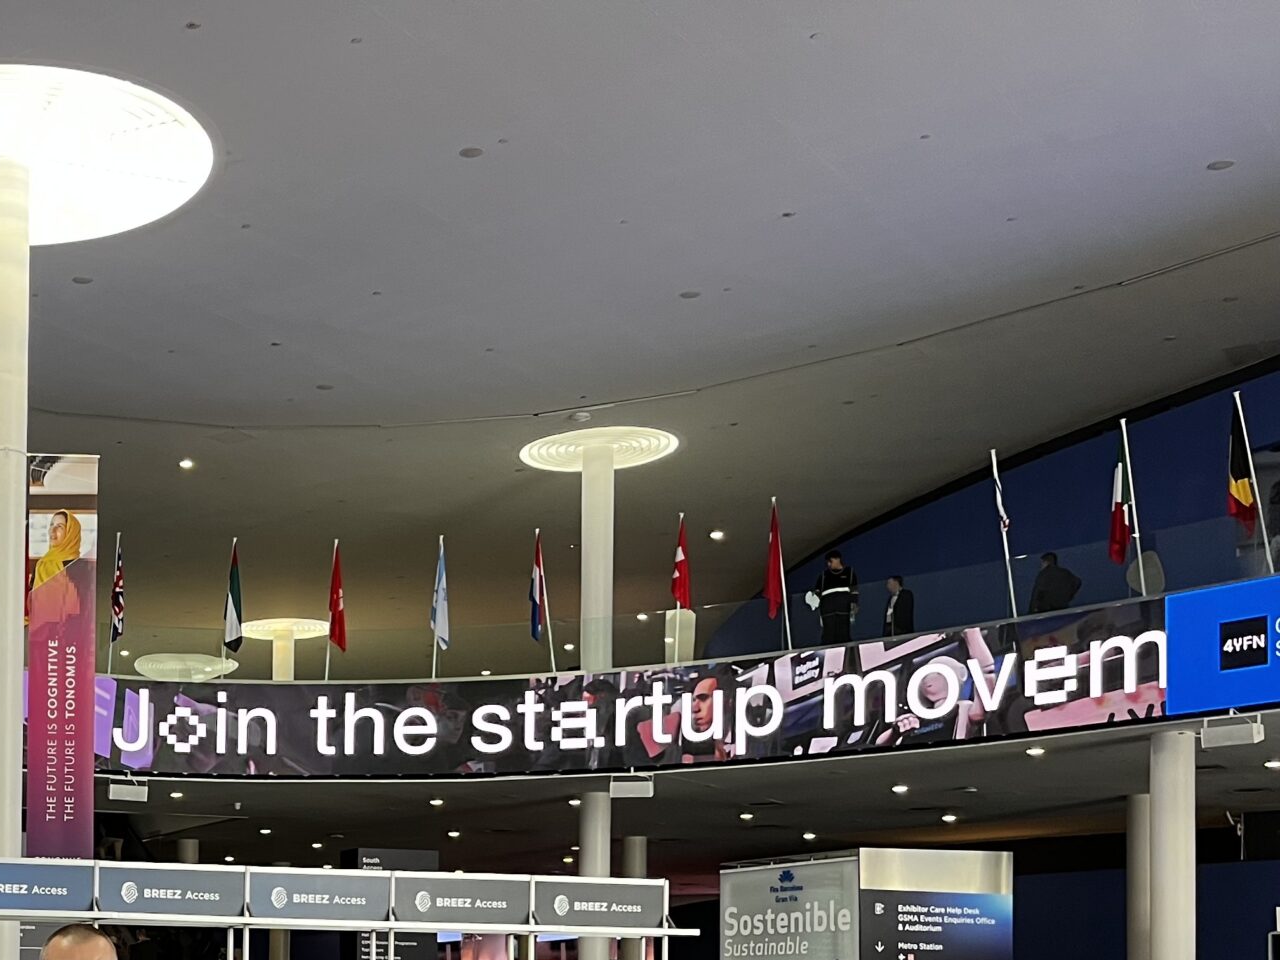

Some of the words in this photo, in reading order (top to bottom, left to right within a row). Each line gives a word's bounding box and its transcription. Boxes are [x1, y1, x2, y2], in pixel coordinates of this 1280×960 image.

[1223, 633, 1265, 653] 4YFN
[47, 636, 59, 719] COGNITIVE.
[65, 642, 77, 719] TONOMUS.
[112, 688, 277, 754] Join
[309, 692, 438, 755] the
[470, 681, 784, 757] startup
[822, 627, 1166, 730] movem
[47, 723, 58, 735] IS
[65, 723, 76, 735] IS
[46, 739, 58, 792] FUTURE
[64, 740, 76, 792] FUTURE
[46, 796, 57, 821] THE
[64, 796, 75, 821] THE
[31, 885, 68, 897] Access
[143, 888, 182, 900] BREEZ
[185, 890, 220, 901] Access
[292, 893, 330, 904] BREEZ
[332, 895, 367, 906] Access
[436, 897, 472, 908] BREEZ
[474, 898, 507, 909] Access
[573, 901, 608, 912] BREEZ
[610, 902, 642, 913] Access
[897, 904, 929, 913] Exhibitor
[929, 906, 946, 914] Care
[946, 907, 962, 915] Help
[963, 907, 980, 915] Desk
[724, 899, 851, 937] Sostenible
[897, 914, 919, 922] GSMA
[919, 915, 943, 923] Events
[943, 916, 975, 925] Enquiries
[975, 917, 996, 925] Office
[904, 924, 943, 932] Auditorium
[724, 935, 809, 957] Sustainable
[897, 942, 919, 950] Metro
[919, 943, 944, 951] Station
